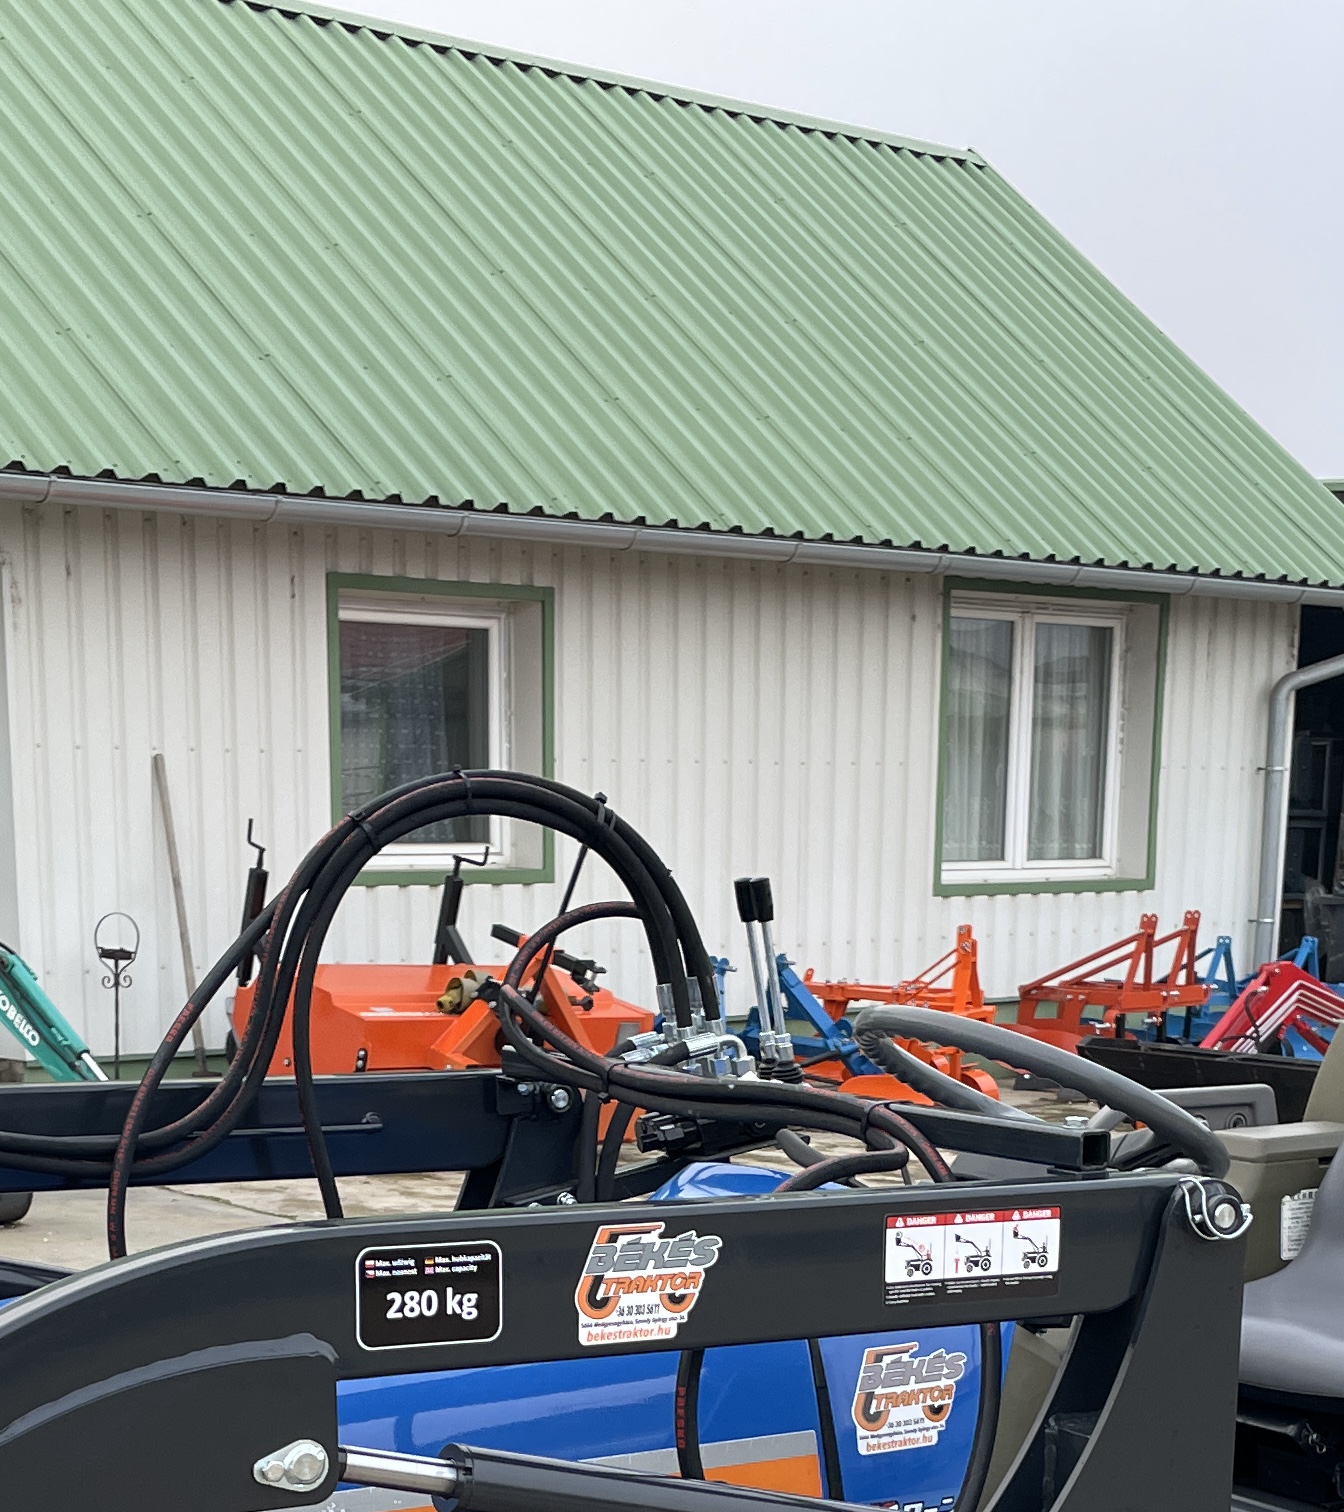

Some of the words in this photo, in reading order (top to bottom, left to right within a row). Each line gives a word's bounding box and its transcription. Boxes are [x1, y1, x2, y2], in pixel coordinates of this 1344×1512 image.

[906, 1216, 937, 1225] DANGER
[965, 1213, 995, 1222] DANGER
[1022, 1209, 1052, 1218] DANGER
[585, 1233, 720, 1274] BÉKÉS
[602, 1272, 702, 1296] TRAKTOR
[386, 1289, 438, 1319] 280
[446, 1286, 478, 1320] kg
[586, 1324, 672, 1343] bekestraktor.hu
[858, 1351, 966, 1391] BÉKÉS
[874, 1384, 955, 1410] TRAKTOR
[866, 1434, 933, 1453] bekestraktor.hu
